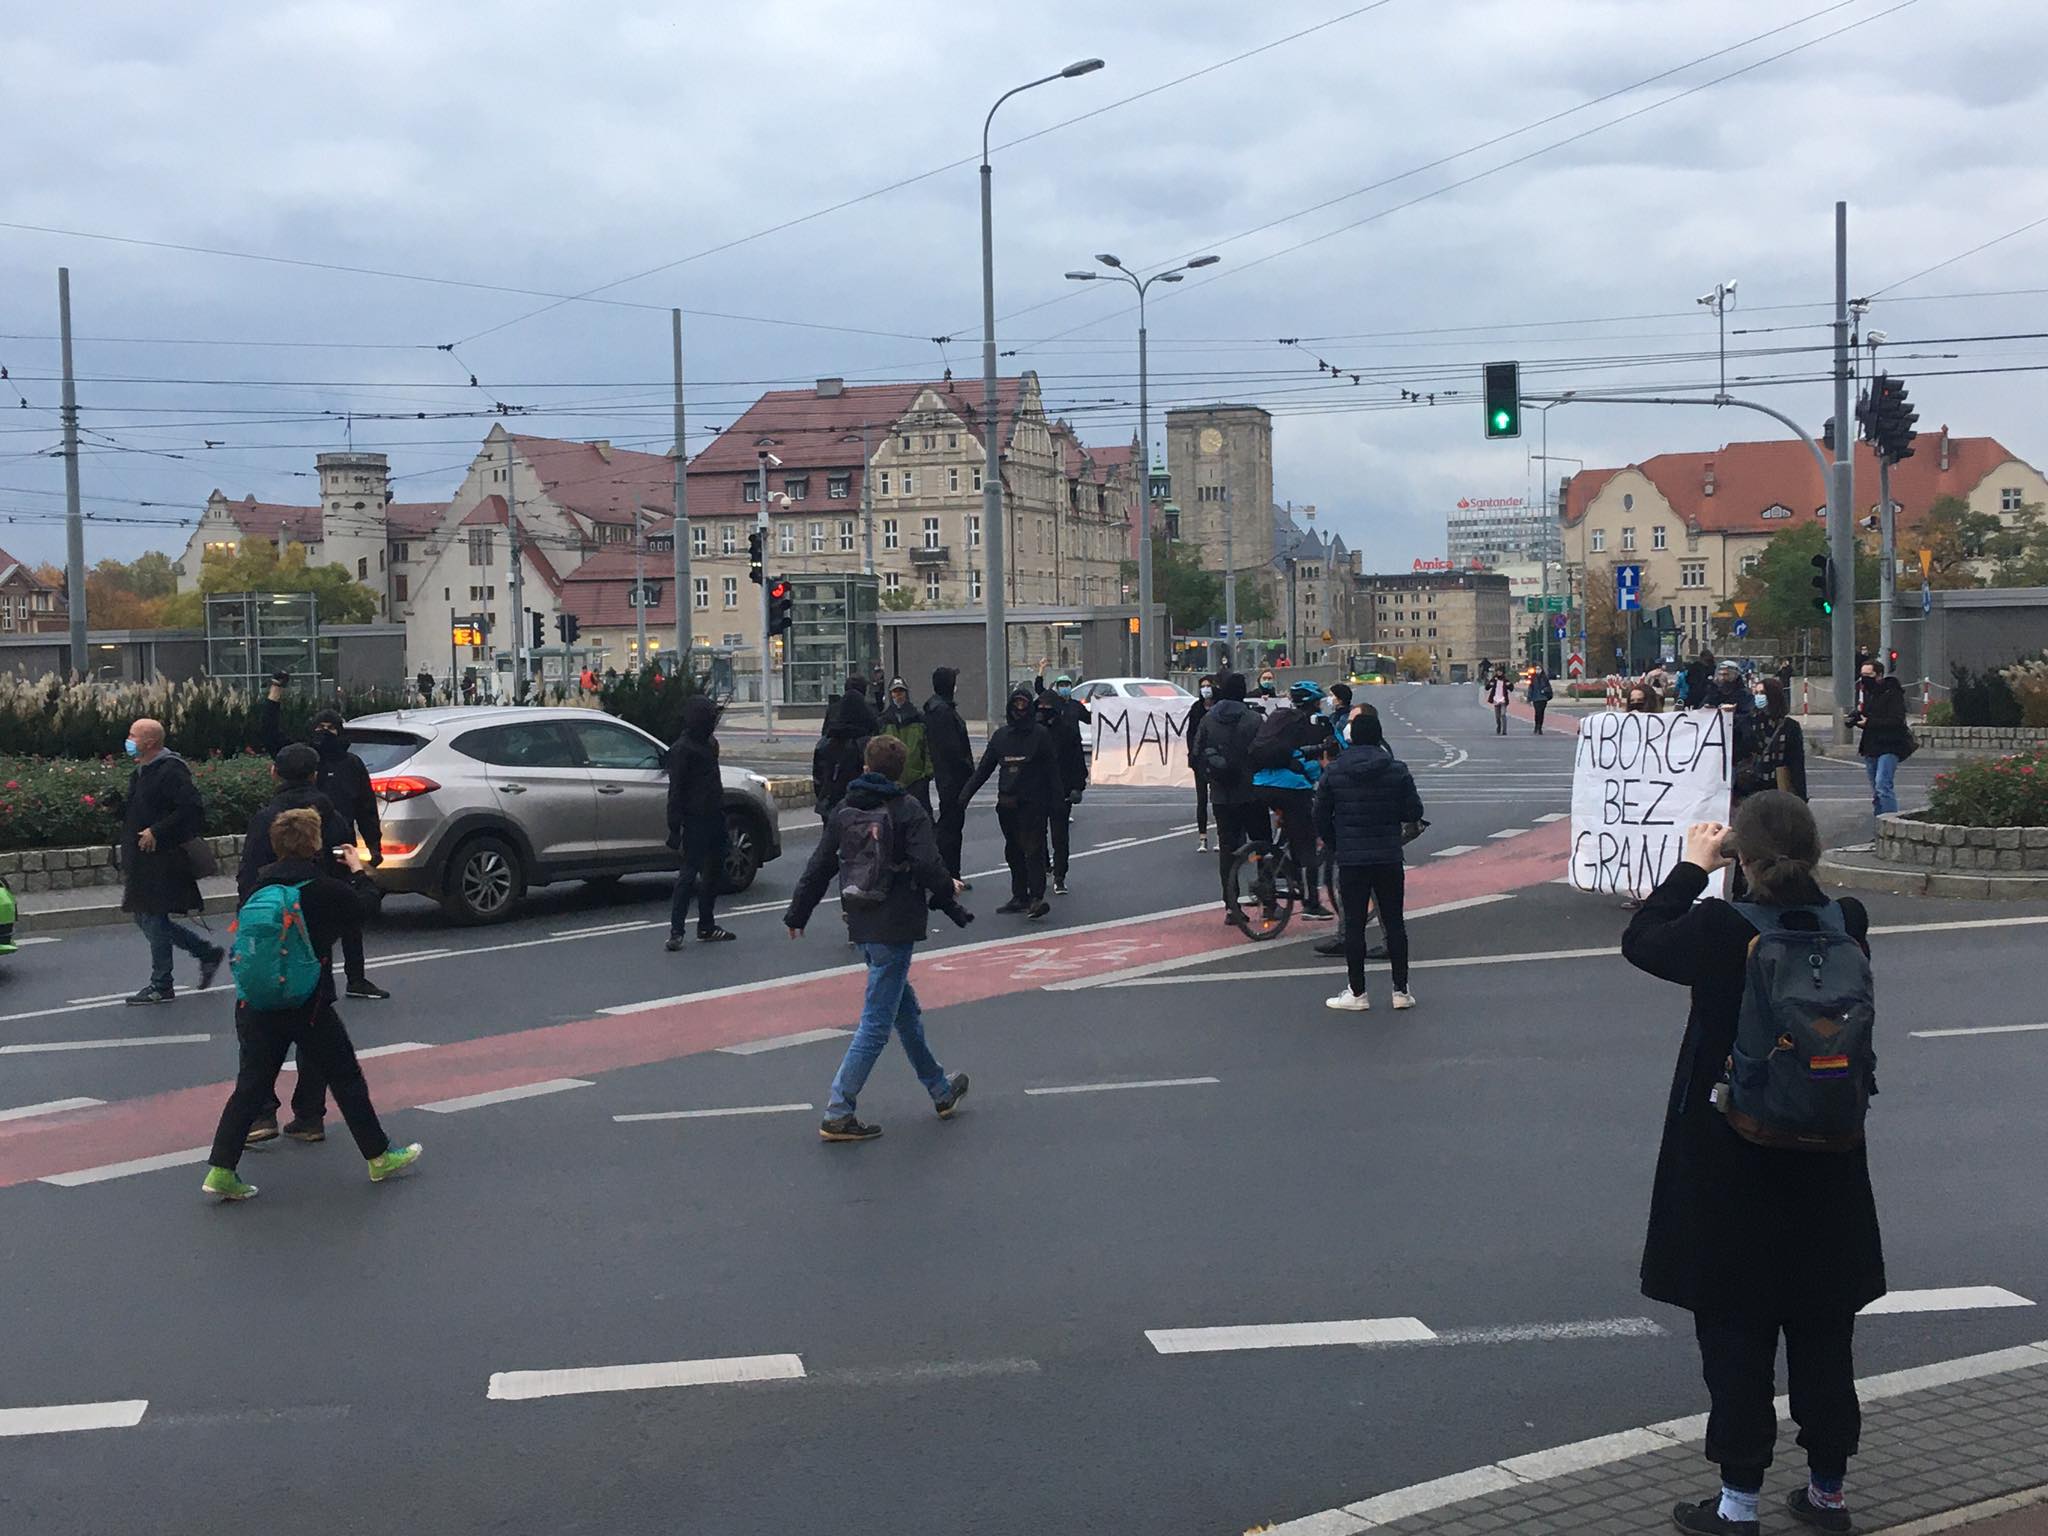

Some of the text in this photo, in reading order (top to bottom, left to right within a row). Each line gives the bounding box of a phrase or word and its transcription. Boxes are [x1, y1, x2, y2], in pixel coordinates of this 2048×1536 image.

[1470, 497, 1523, 508] Santander
[1413, 557, 1454, 570] Amica
[1604, 779, 1674, 825] BEZ
